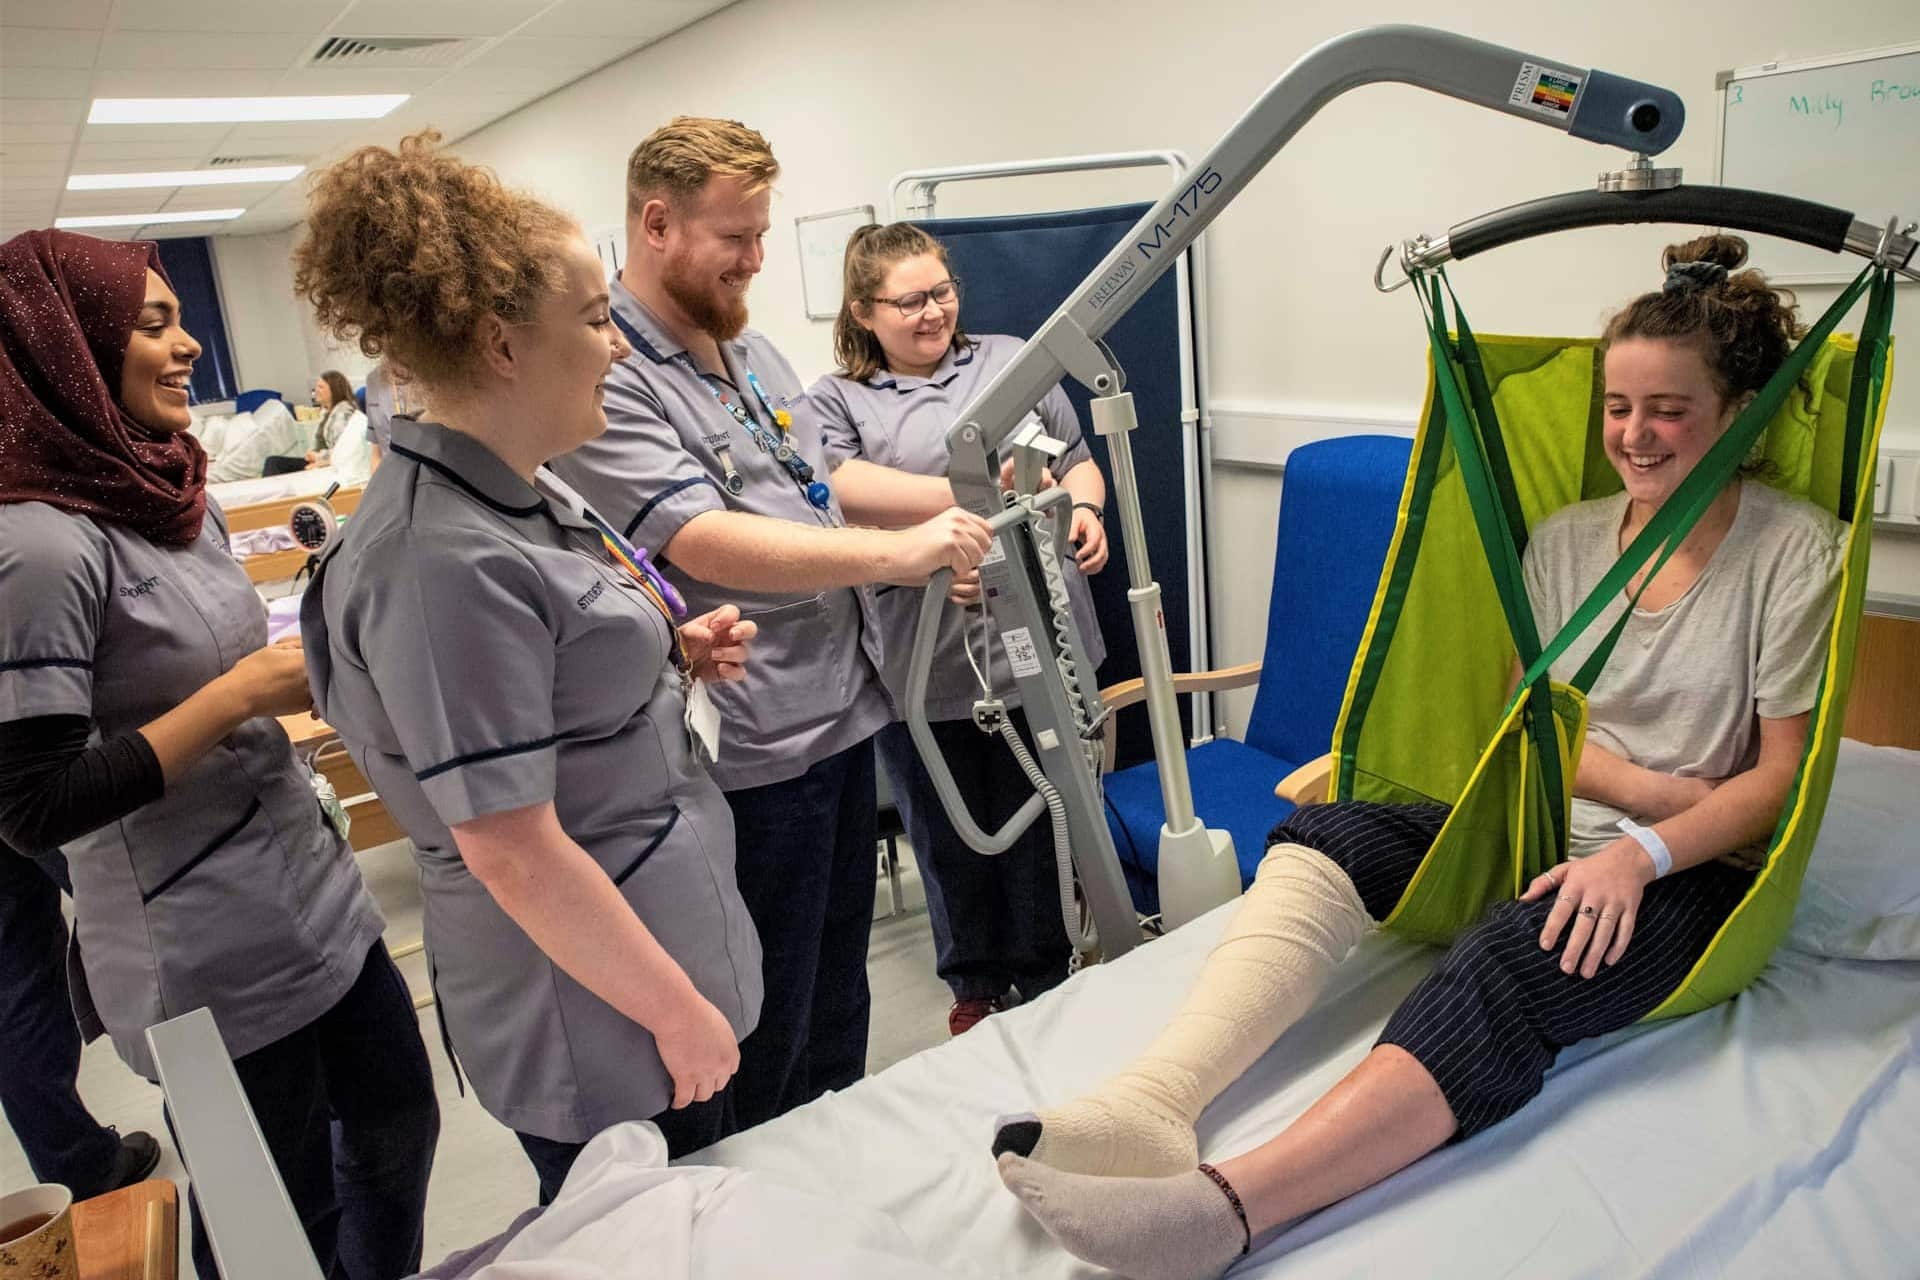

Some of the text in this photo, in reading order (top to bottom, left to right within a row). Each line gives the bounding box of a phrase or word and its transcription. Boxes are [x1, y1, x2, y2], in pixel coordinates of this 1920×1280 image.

[1512, 65, 1534, 101] PRISM
[1728, 85, 1743, 106] 3
[1789, 94, 1843, 129] Milly
[1089, 167, 1223, 309] FREEWAY M-175
